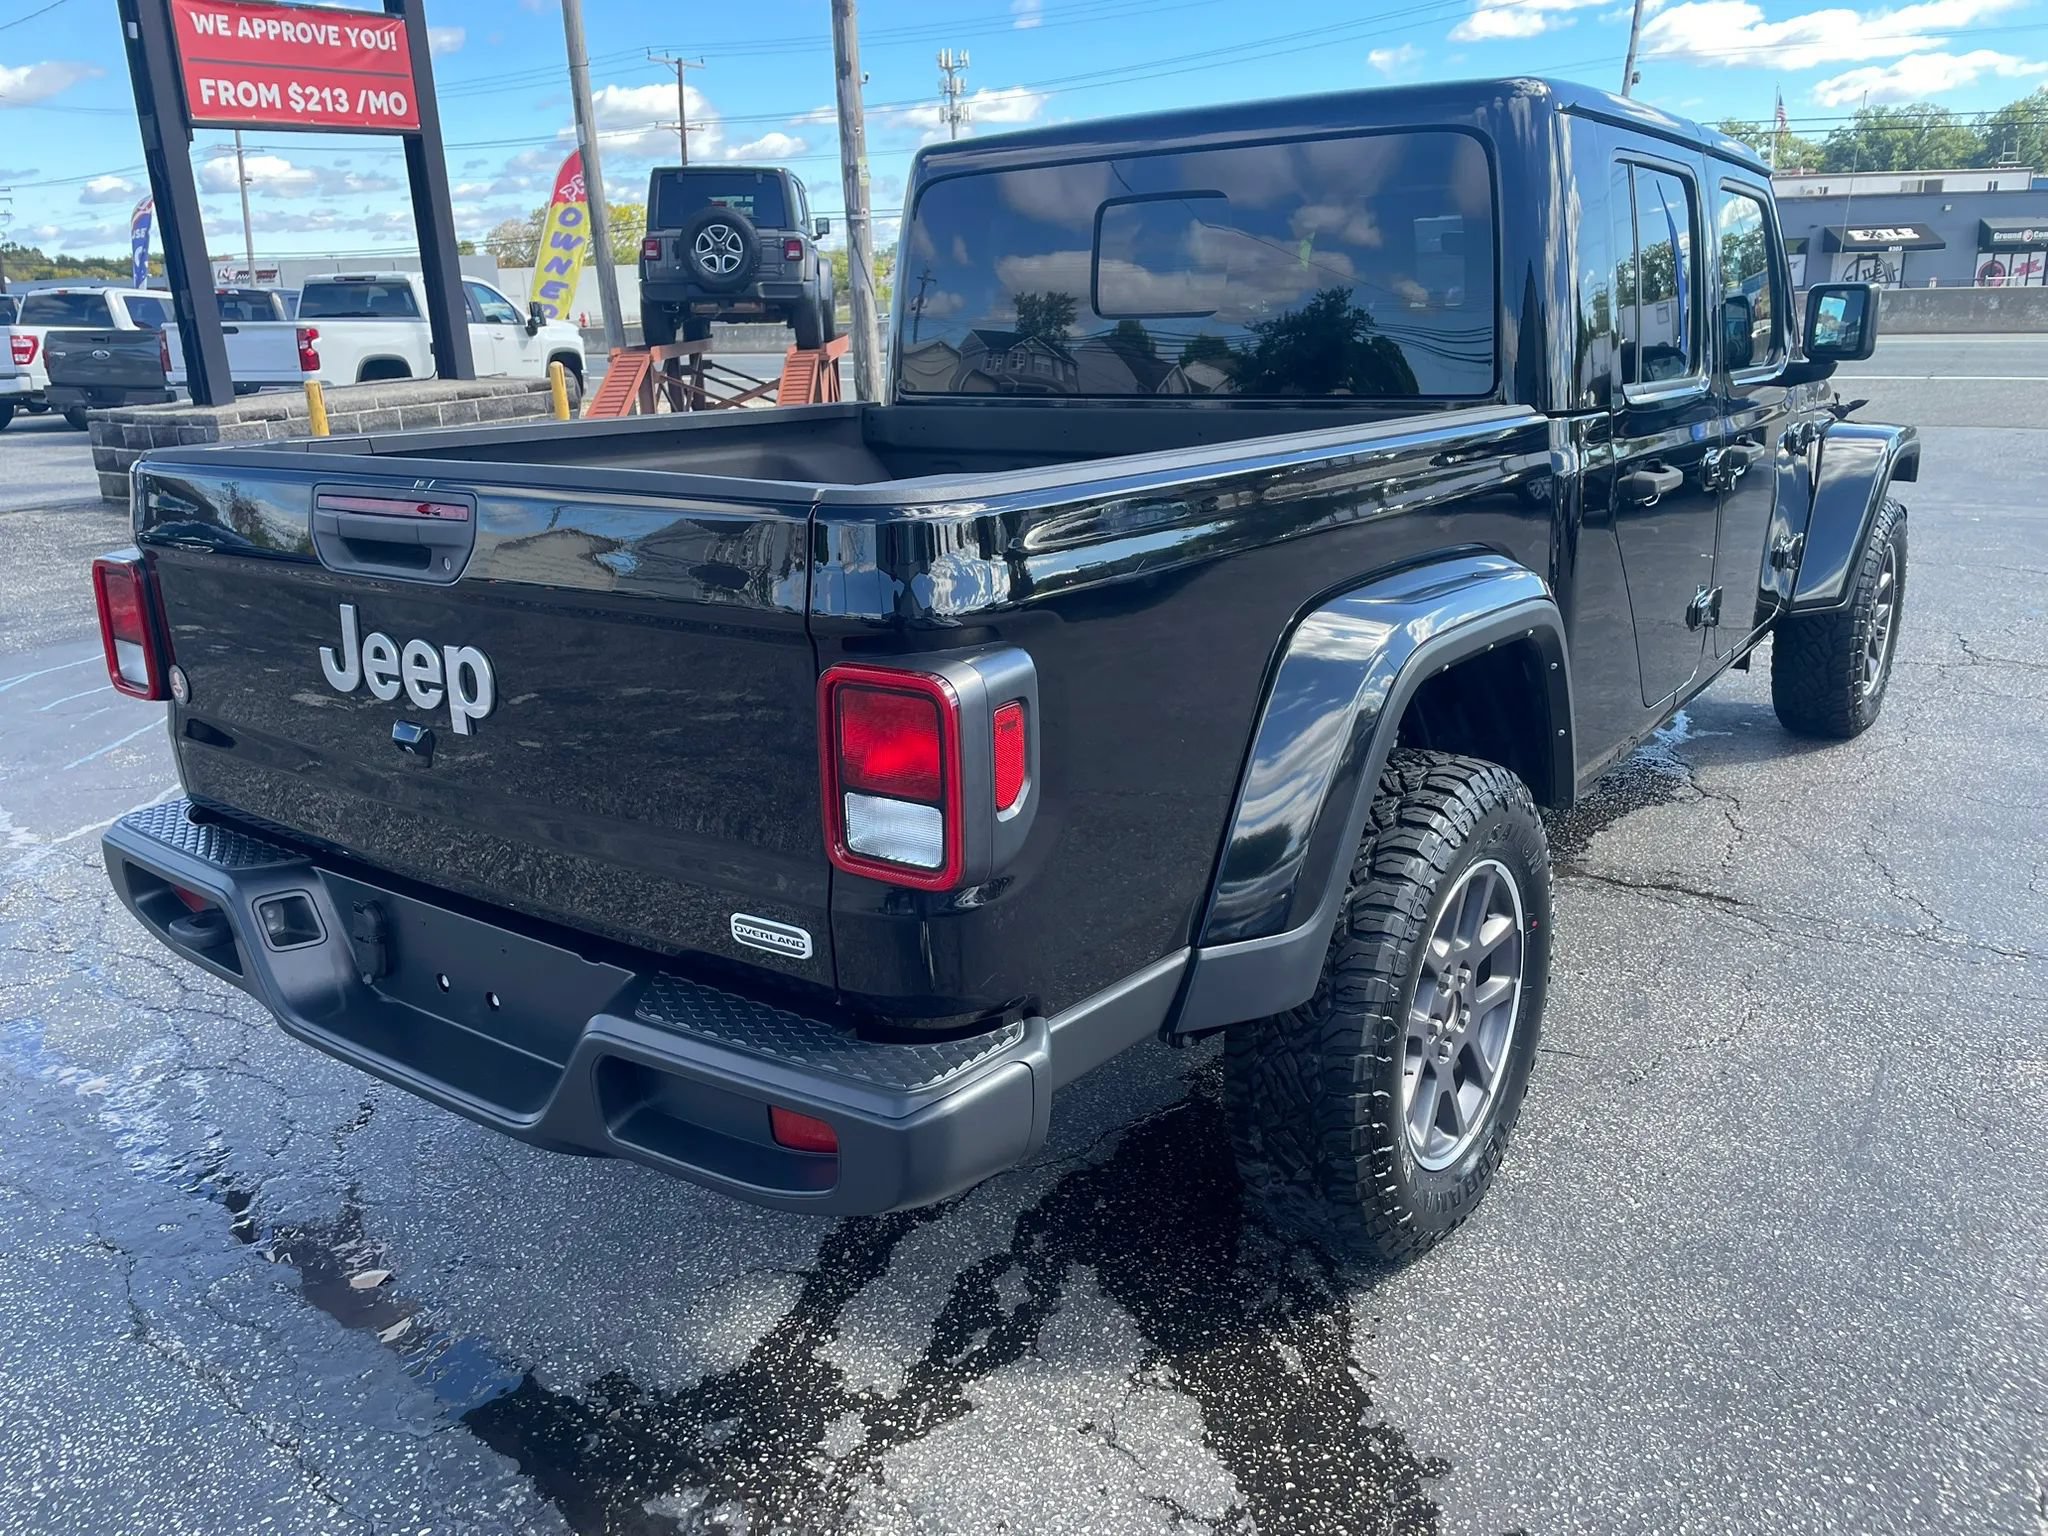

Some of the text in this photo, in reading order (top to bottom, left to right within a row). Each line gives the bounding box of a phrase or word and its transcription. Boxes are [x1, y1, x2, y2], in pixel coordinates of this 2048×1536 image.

[190, 12, 397, 51] WE APPROVE YOU!
[199, 79, 408, 117] FROM $213 /MO
[1847, 228, 1920, 241] EXILE
[319, 604, 497, 735] Jeep
[734, 925, 806, 949] OVERLAND
